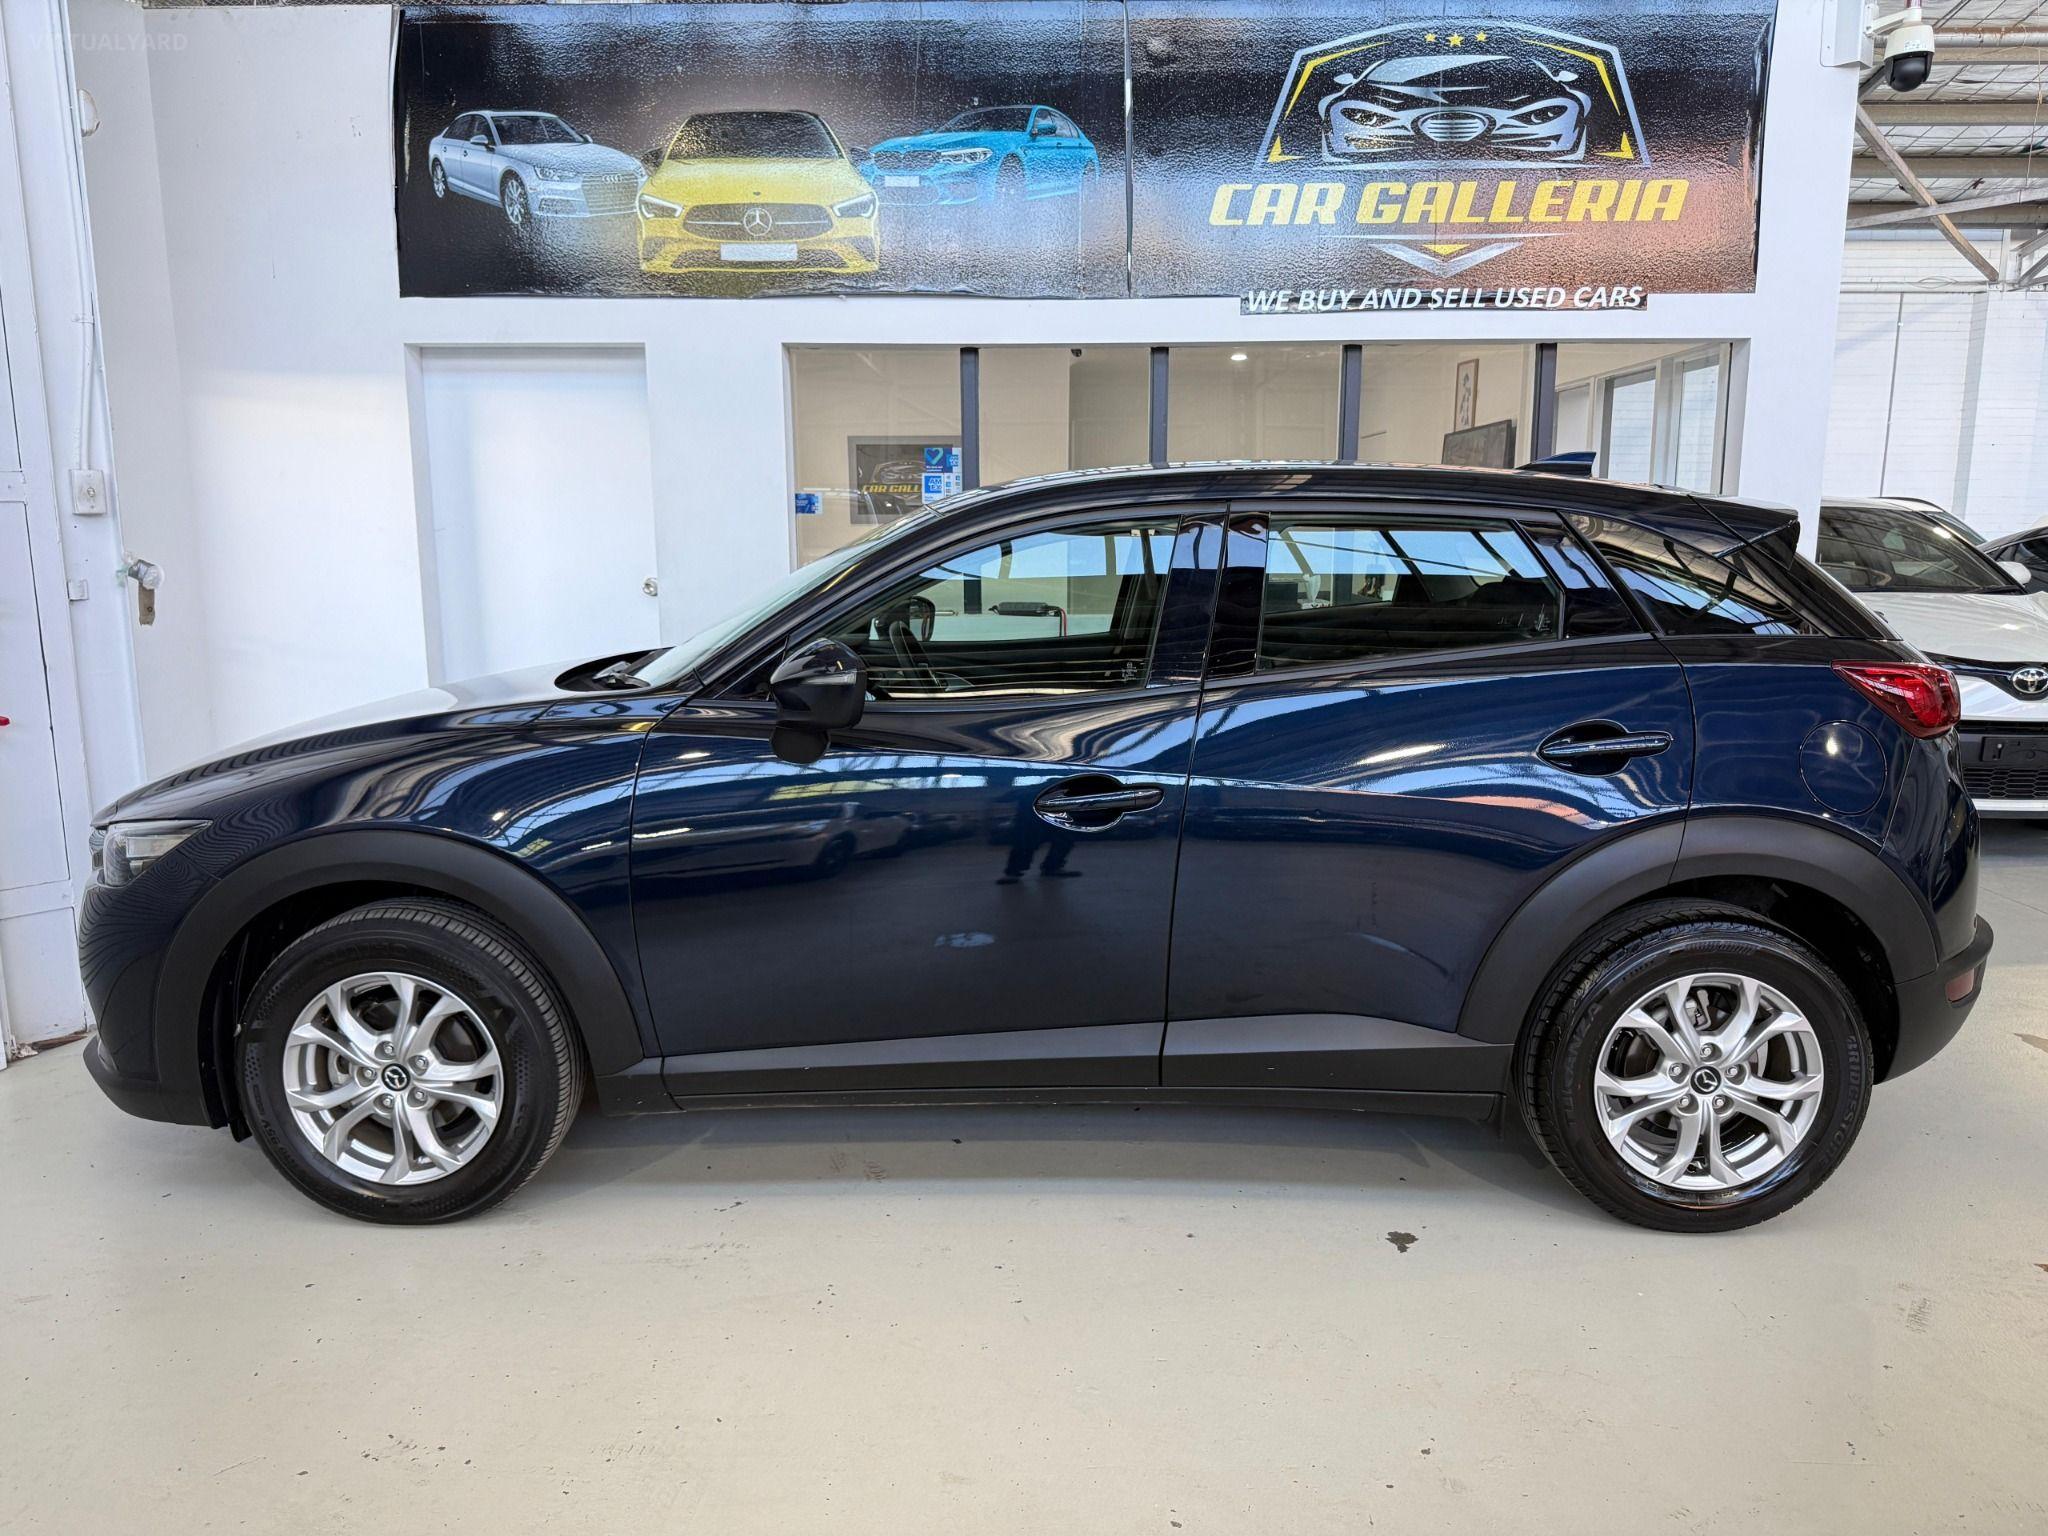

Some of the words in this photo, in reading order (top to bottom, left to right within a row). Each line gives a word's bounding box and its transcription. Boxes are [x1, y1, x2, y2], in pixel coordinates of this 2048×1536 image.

[1209, 182, 1346, 226] CAR
[1356, 179, 1689, 224] GALLERIA
[1248, 289, 1292, 312] WE
[1297, 288, 1356, 311] BUY
[1360, 287, 1422, 310] AND
[1428, 287, 1485, 310] SELL
[1494, 287, 1565, 308] USED
[1573, 286, 1642, 308] CARS
[863, 484, 888, 493] CAR
[889, 484, 921, 493] GALL
